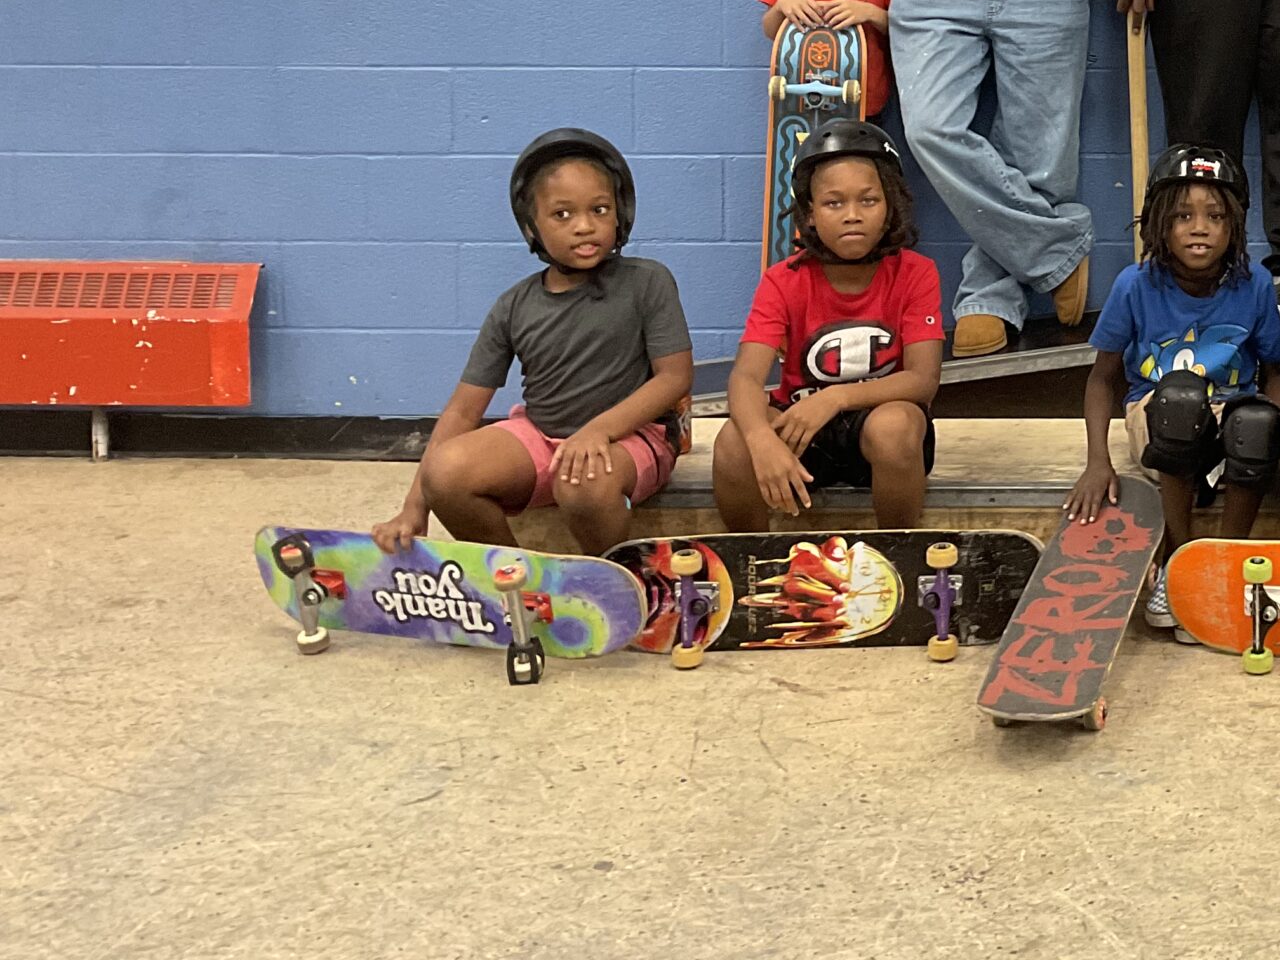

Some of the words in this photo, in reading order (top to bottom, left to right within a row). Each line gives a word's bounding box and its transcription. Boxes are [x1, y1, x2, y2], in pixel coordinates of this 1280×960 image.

[394, 563, 465, 599] you
[375, 590, 495, 632] Thank
[978, 563, 1137, 707] ZERO
